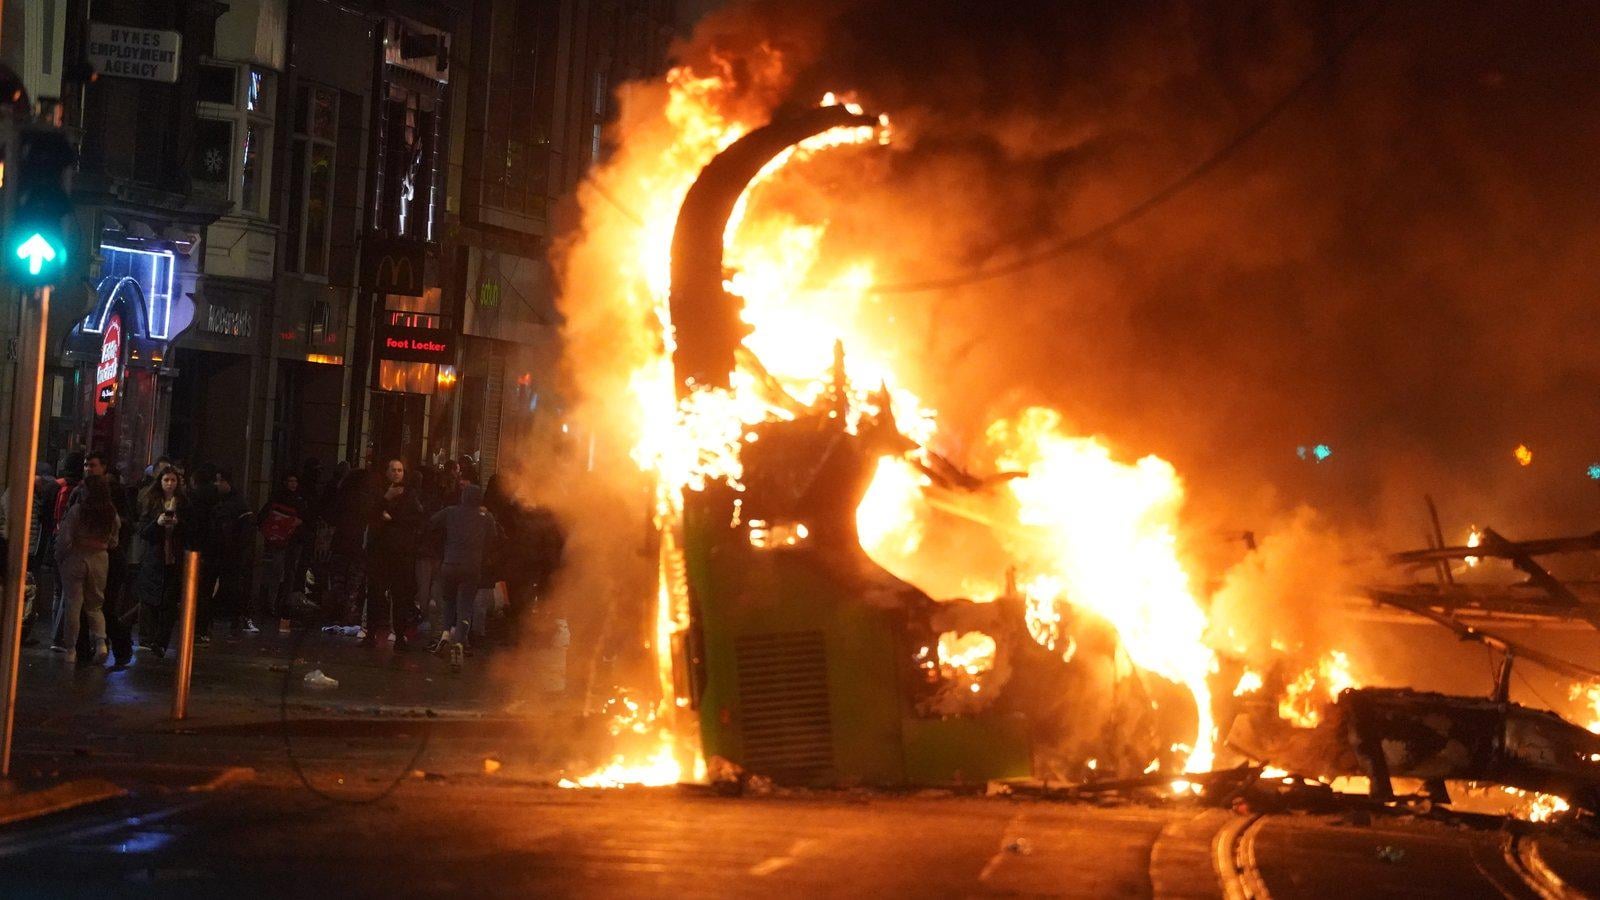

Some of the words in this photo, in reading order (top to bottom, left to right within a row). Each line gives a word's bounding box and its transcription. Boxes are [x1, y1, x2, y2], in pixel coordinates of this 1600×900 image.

[112, 29, 160, 46] HYNES
[90, 42, 175, 62] EMPLOYMENT
[104, 60, 158, 77] AGENCY
[386, 337, 409, 349] Foot
[411, 339, 446, 352] Locker
